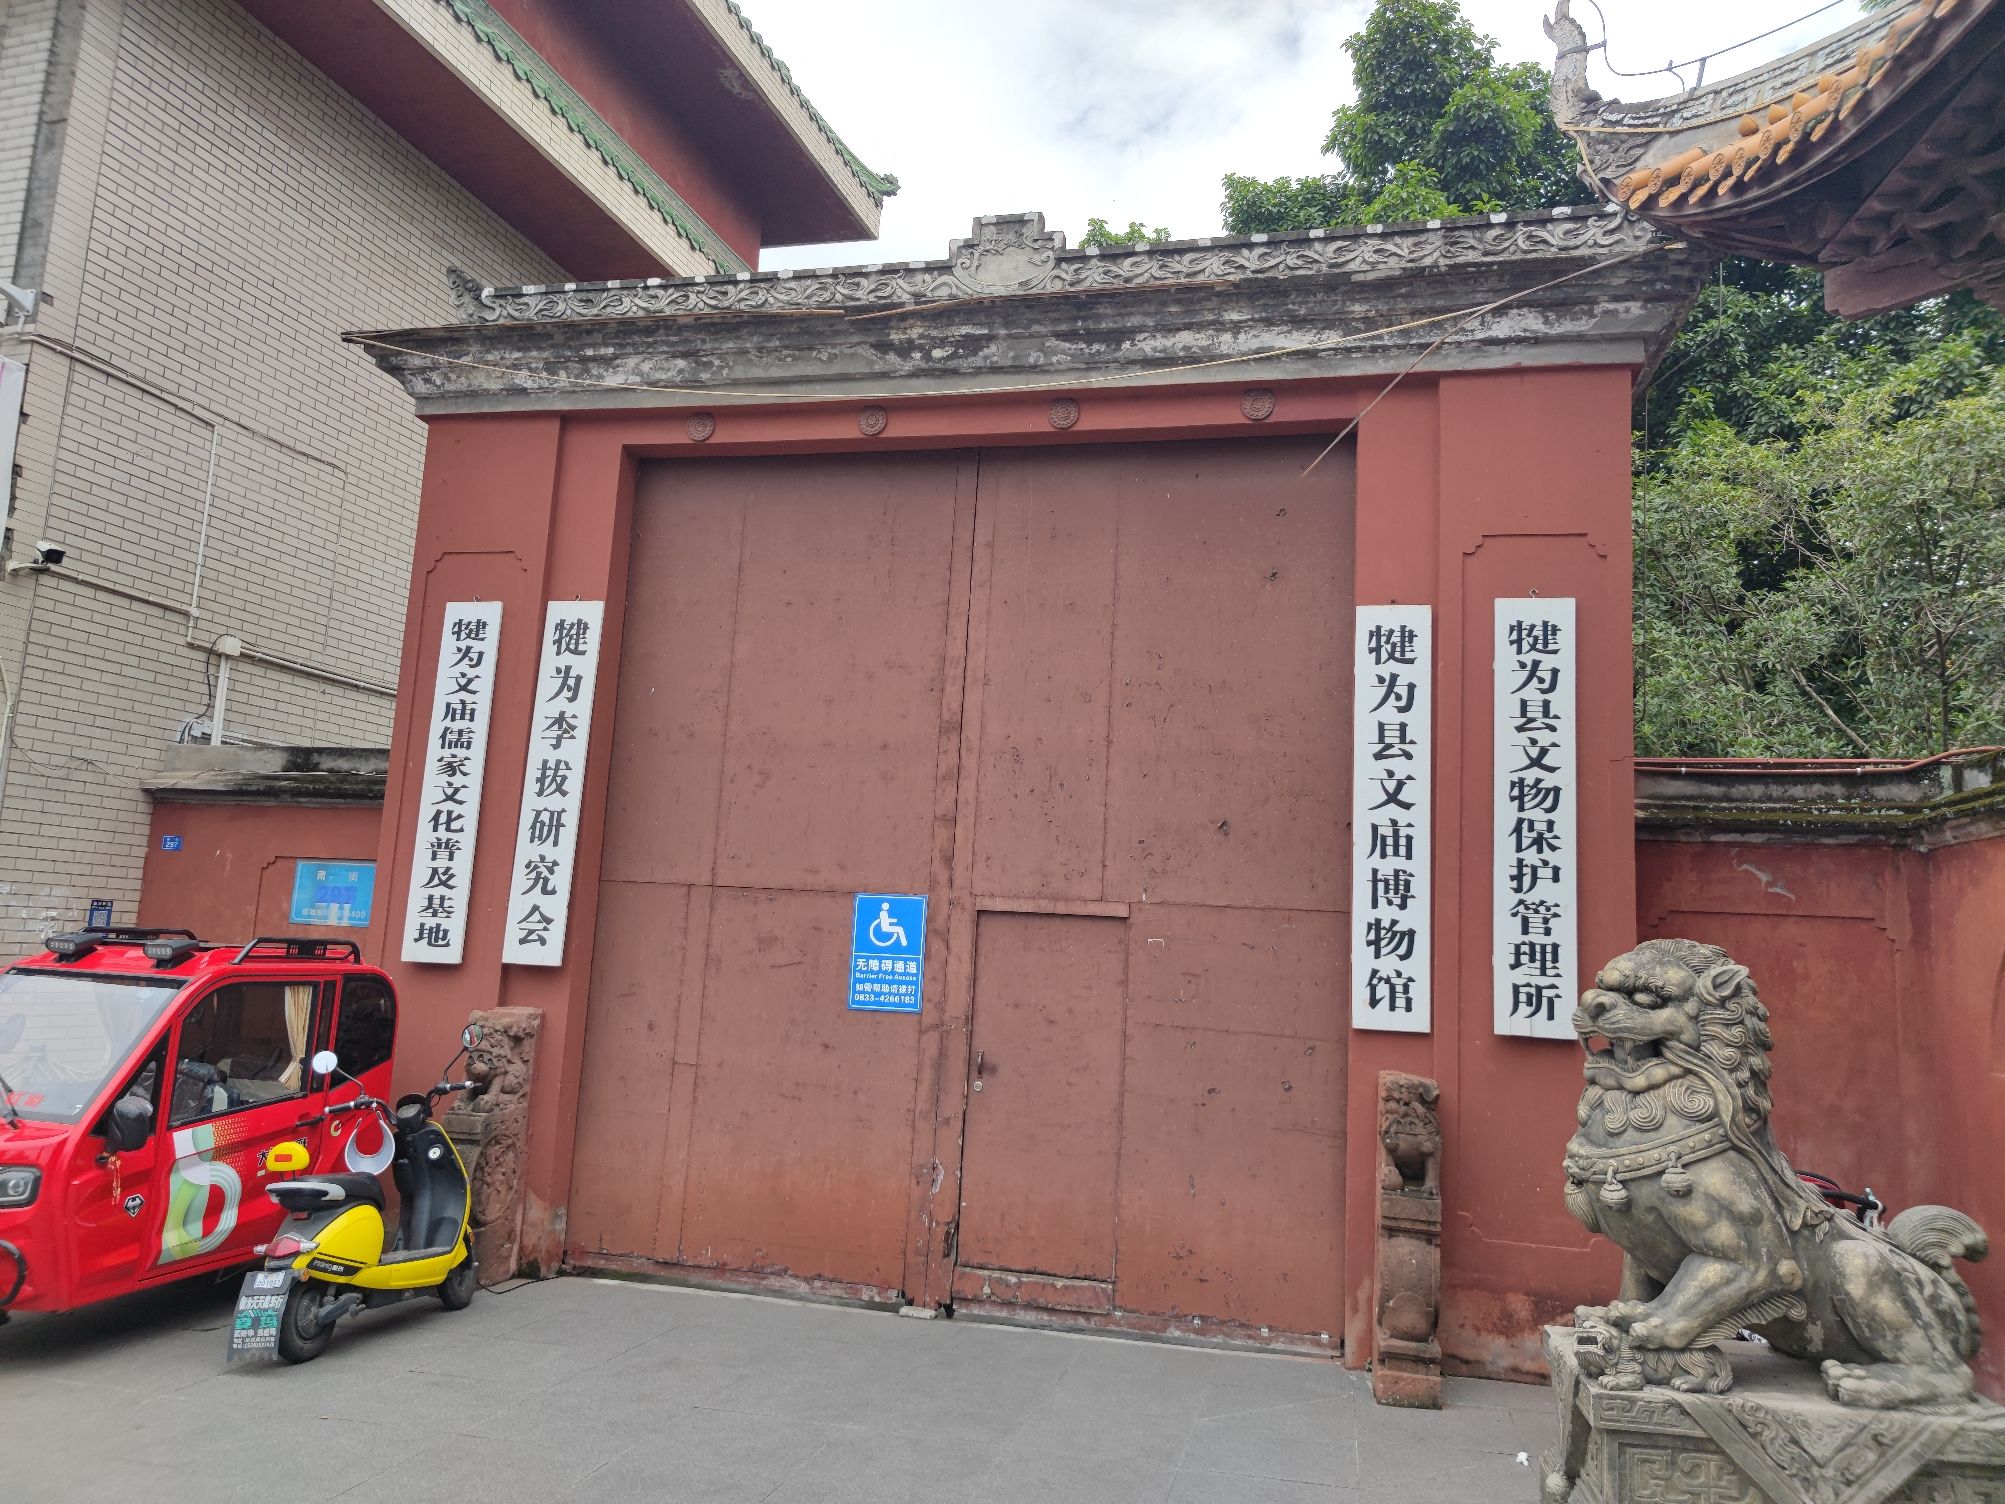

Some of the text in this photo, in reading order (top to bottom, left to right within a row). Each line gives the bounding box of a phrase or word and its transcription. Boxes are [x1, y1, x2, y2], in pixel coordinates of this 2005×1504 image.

[413, 617, 489, 949] 犍为文庙儒家文化普及基地
[516, 617, 590, 948] 犍为李拔研究会
[1364, 623, 1419, 1013] 犍为县文庙博物馆
[1507, 618, 1563, 1022] 犍为县文物保护管理所
[854, 994, 915, 1003] 0833-4266183
[855, 982, 916, 994] 如需帮助请拨打
[856, 958, 917, 973] 无障碍通道
